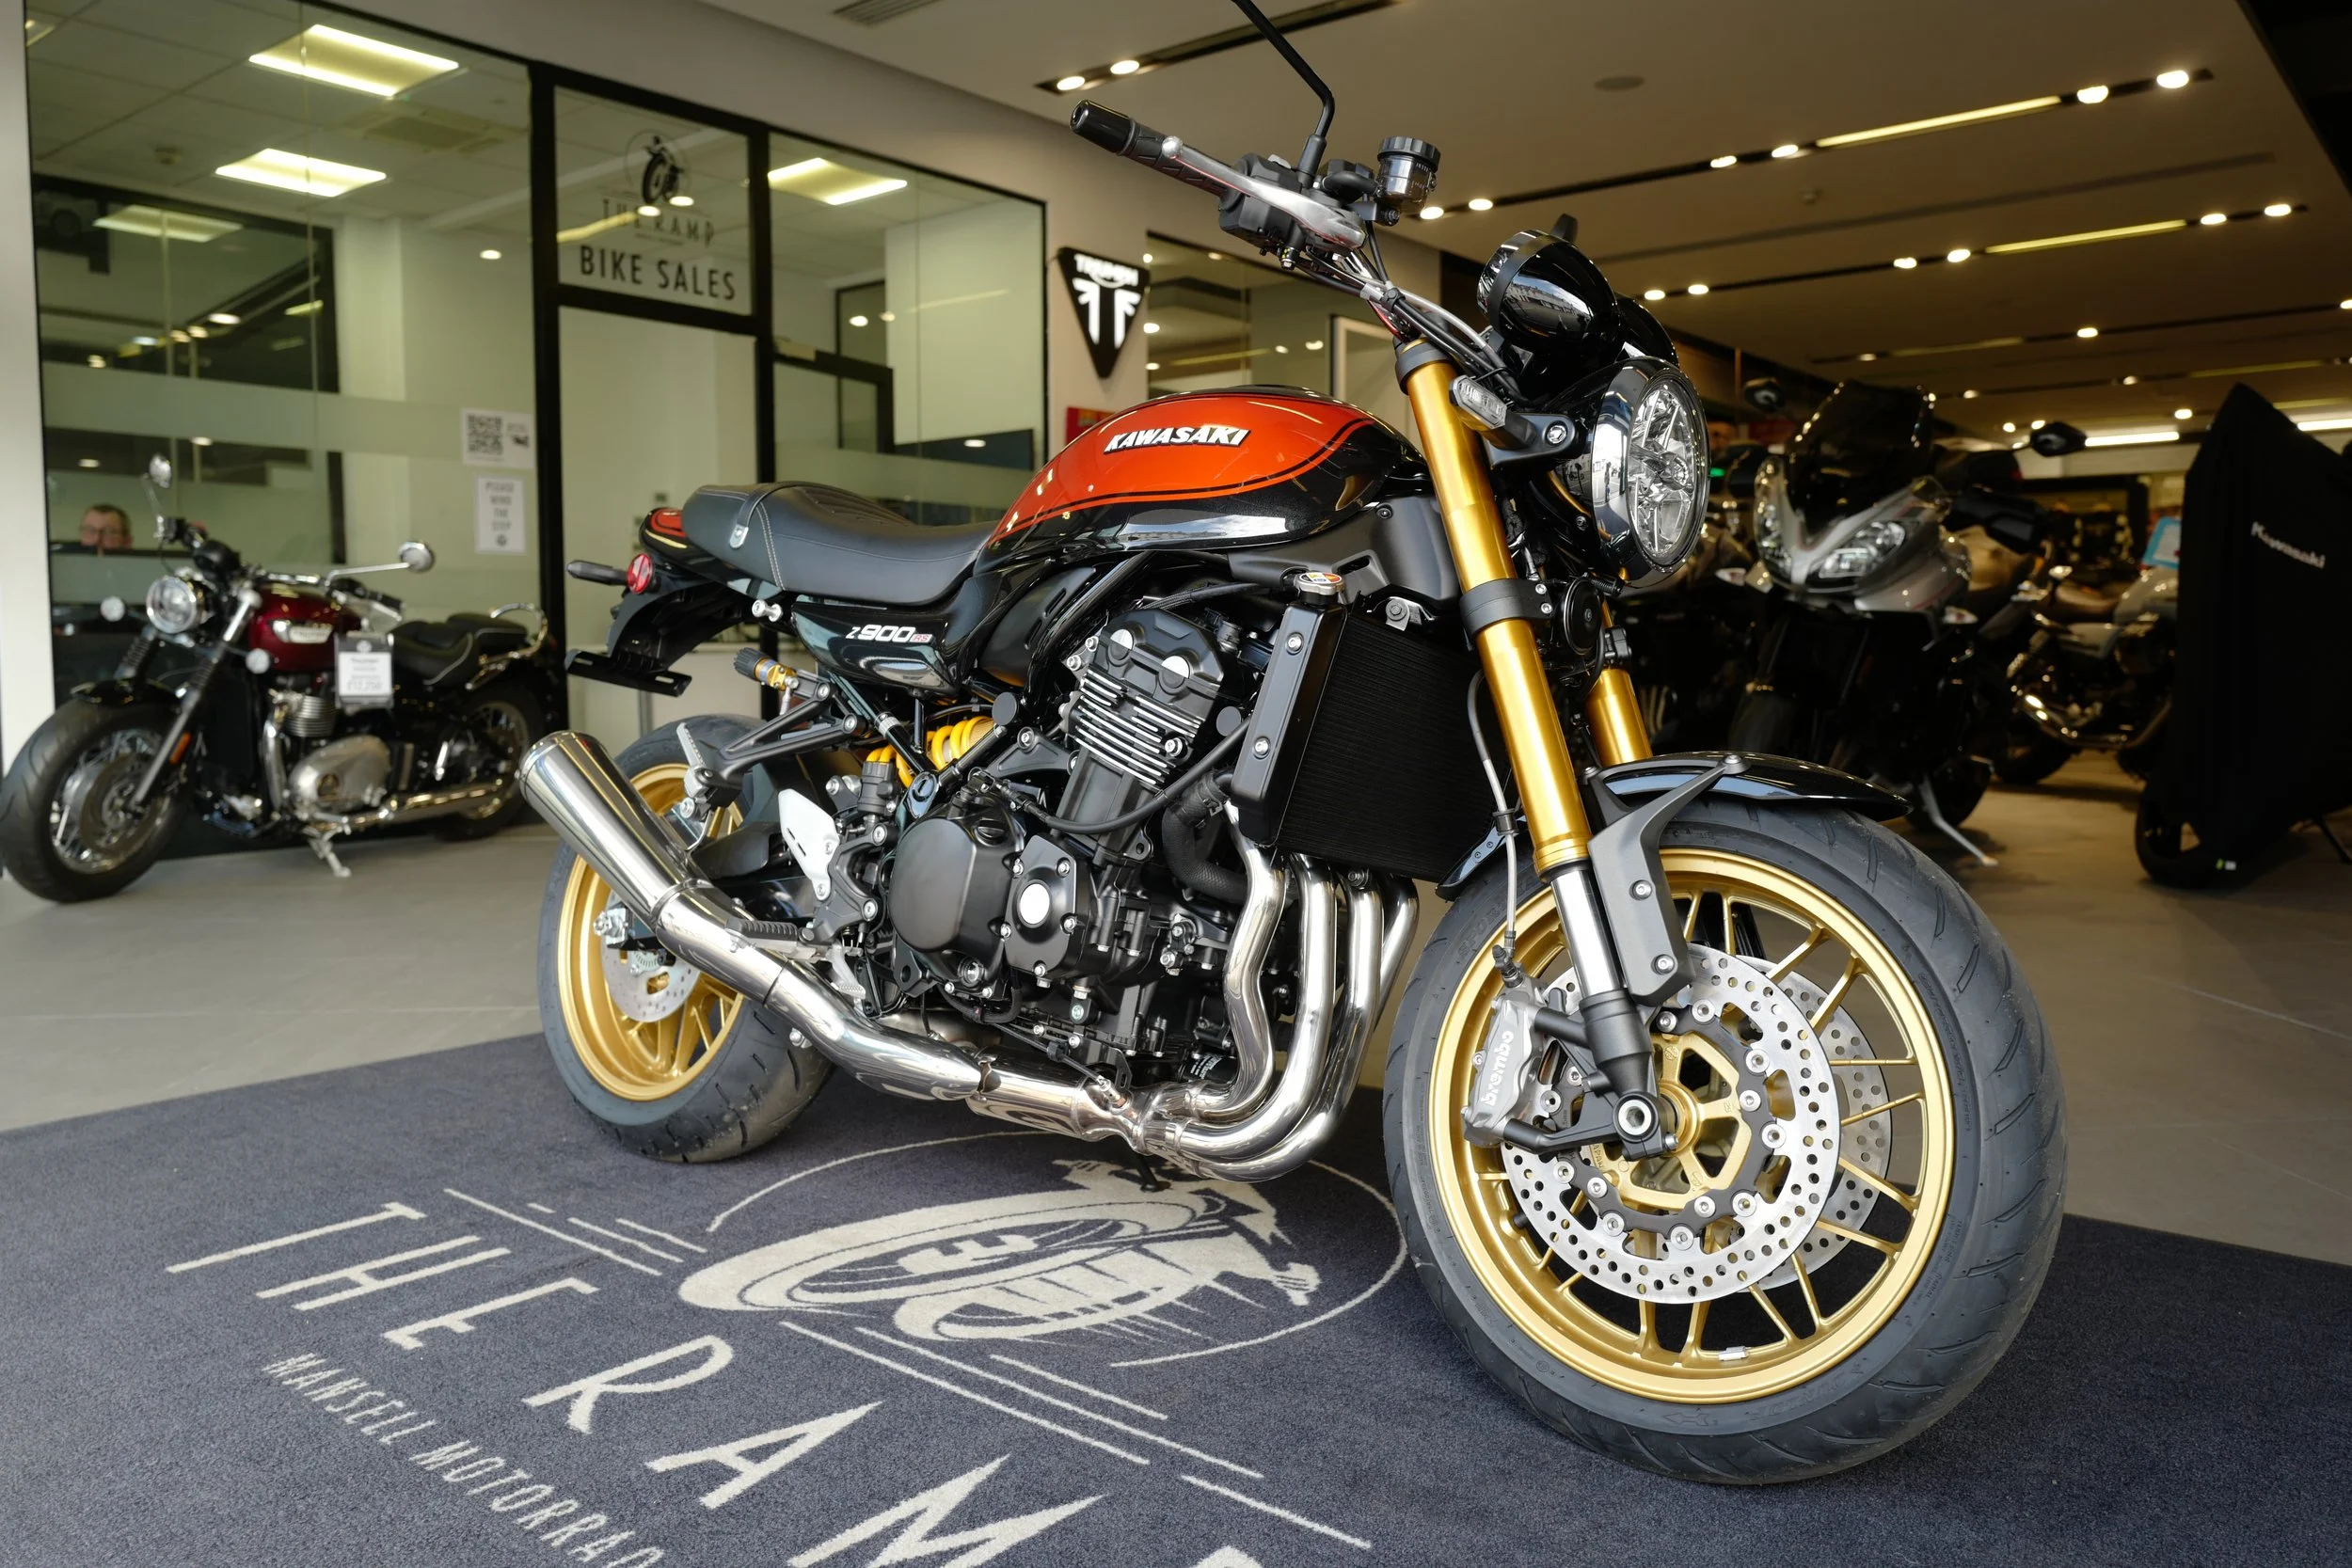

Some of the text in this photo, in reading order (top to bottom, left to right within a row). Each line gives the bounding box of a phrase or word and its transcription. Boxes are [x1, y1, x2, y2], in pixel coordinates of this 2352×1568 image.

[580, 245, 737, 301] BIKE SALES
[1104, 427, 1250, 454] KAWASAKI
[1481, 1030, 1515, 1107] brembo
[165, 1201, 1263, 1568] THE RAM
[262, 1352, 437, 1445] MANSELL
